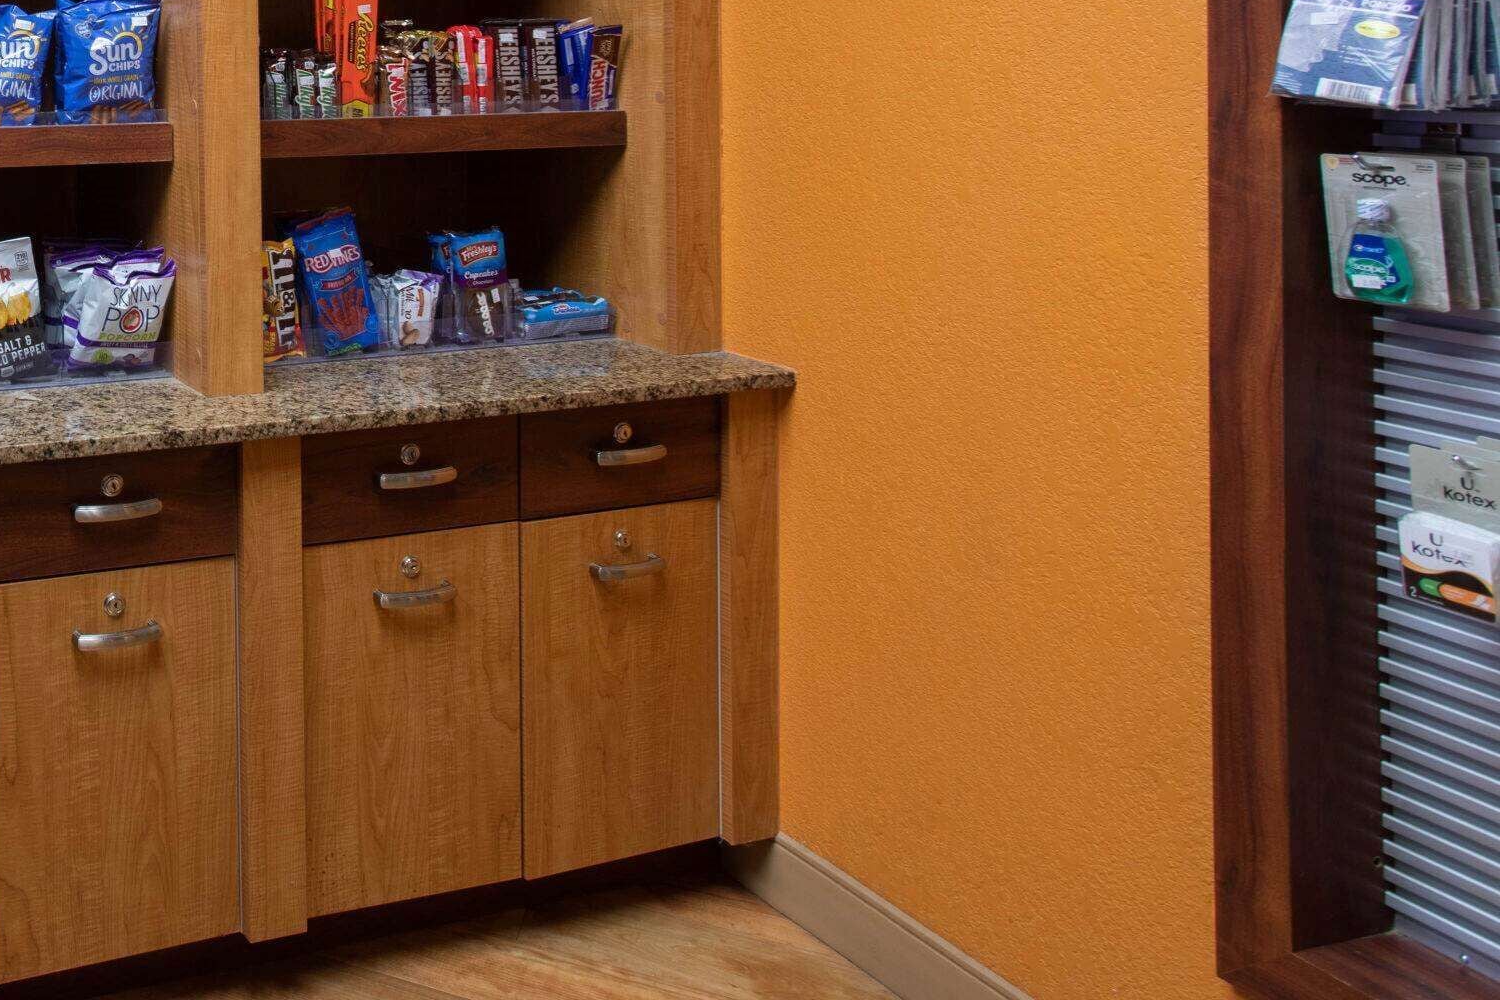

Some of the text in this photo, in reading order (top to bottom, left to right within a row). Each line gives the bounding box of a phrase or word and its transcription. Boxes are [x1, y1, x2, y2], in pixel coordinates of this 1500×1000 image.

[355, 12, 375, 70] Reese's
[1, 59, 35, 70] CHIPS
[89, 37, 142, 76] Sun
[108, 59, 141, 72] CHIPS
[89, 81, 145, 102] ORIGINAL
[1352, 172, 1407, 188] scope
[304, 255, 328, 273] RED
[102, 305, 161, 334] POP
[23, 334, 32, 347] &
[12, 342, 46, 362] PEPPER
[1443, 486, 1498, 511] kotex
[1411, 541, 1468, 568] kotex
